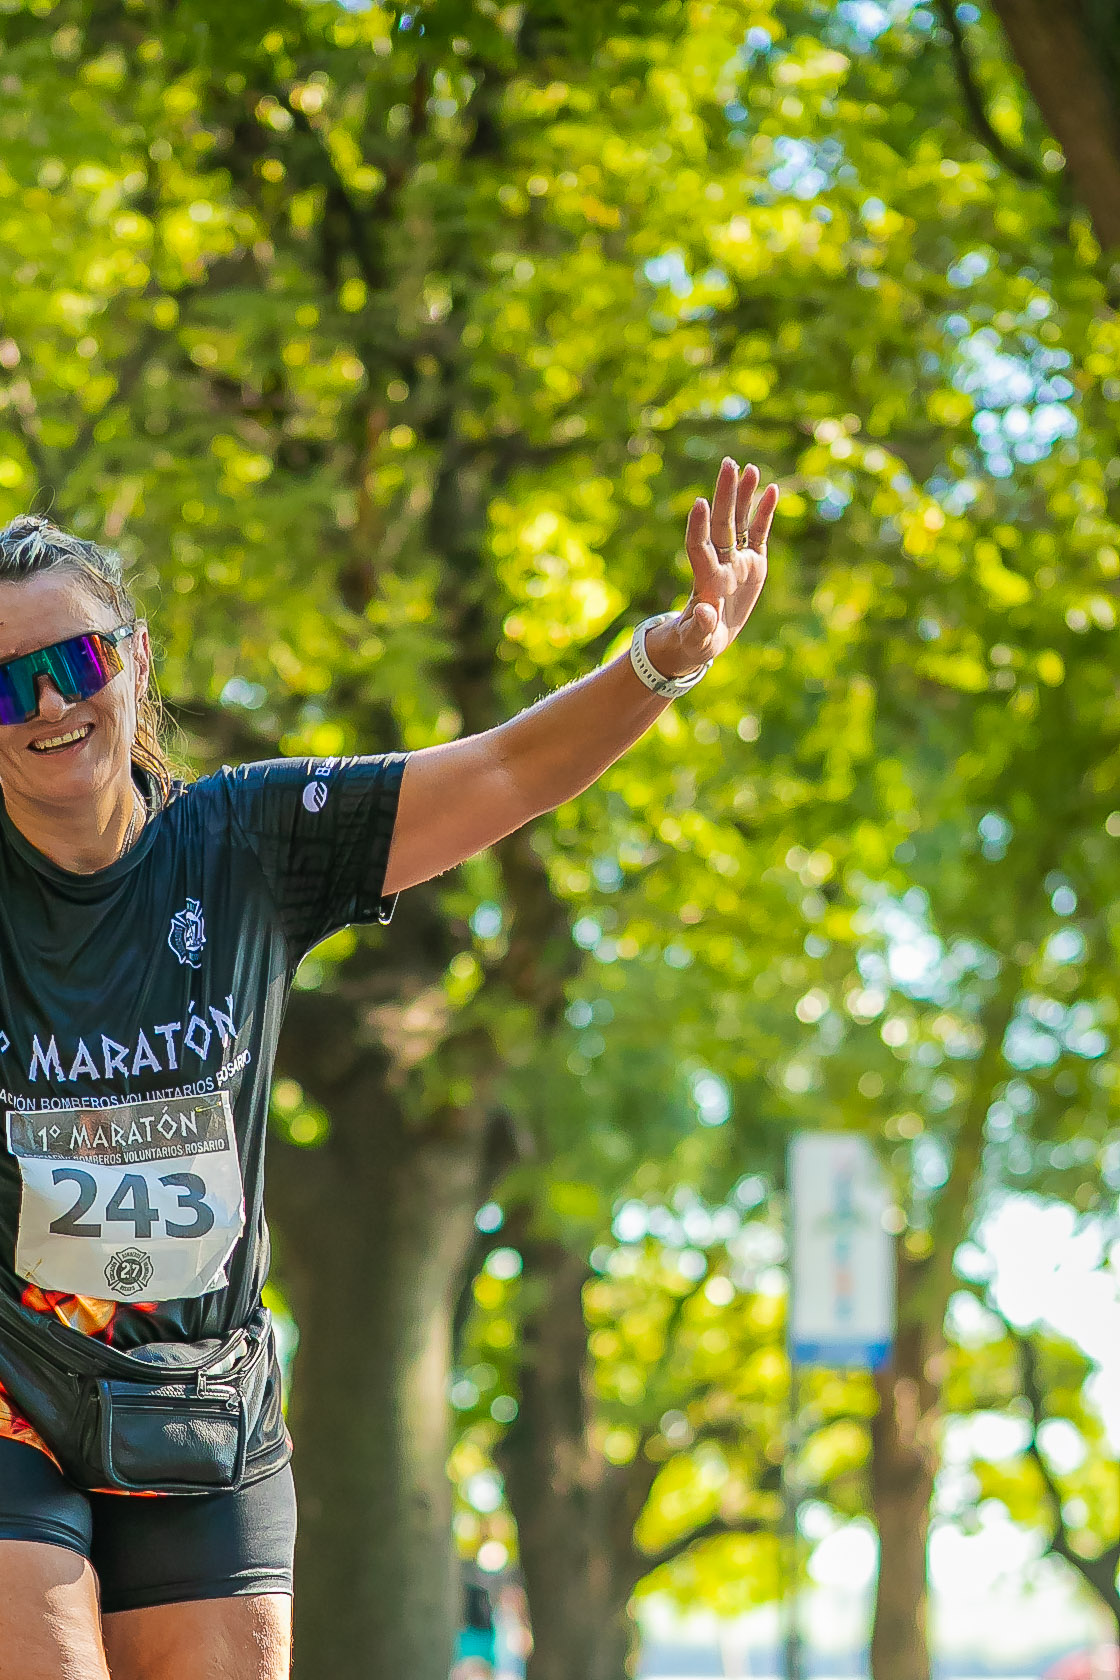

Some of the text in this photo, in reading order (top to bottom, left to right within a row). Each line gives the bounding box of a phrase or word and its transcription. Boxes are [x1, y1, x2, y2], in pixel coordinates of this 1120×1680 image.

[28, 994, 239, 1082] MARATÓN
[40, 1095, 119, 1111] BOMBEROS
[121, 1076, 215, 1105] VOLUNTARIOS
[216, 1048, 252, 1088] ROSARIO
[69, 1105, 198, 1150] MARATÓN
[123, 1144, 183, 1163] VOLUNTARIOS
[184, 1138, 226, 1155] ROSARIO
[49, 1167, 215, 1239] 243
[120, 1262, 140, 1279] 27
